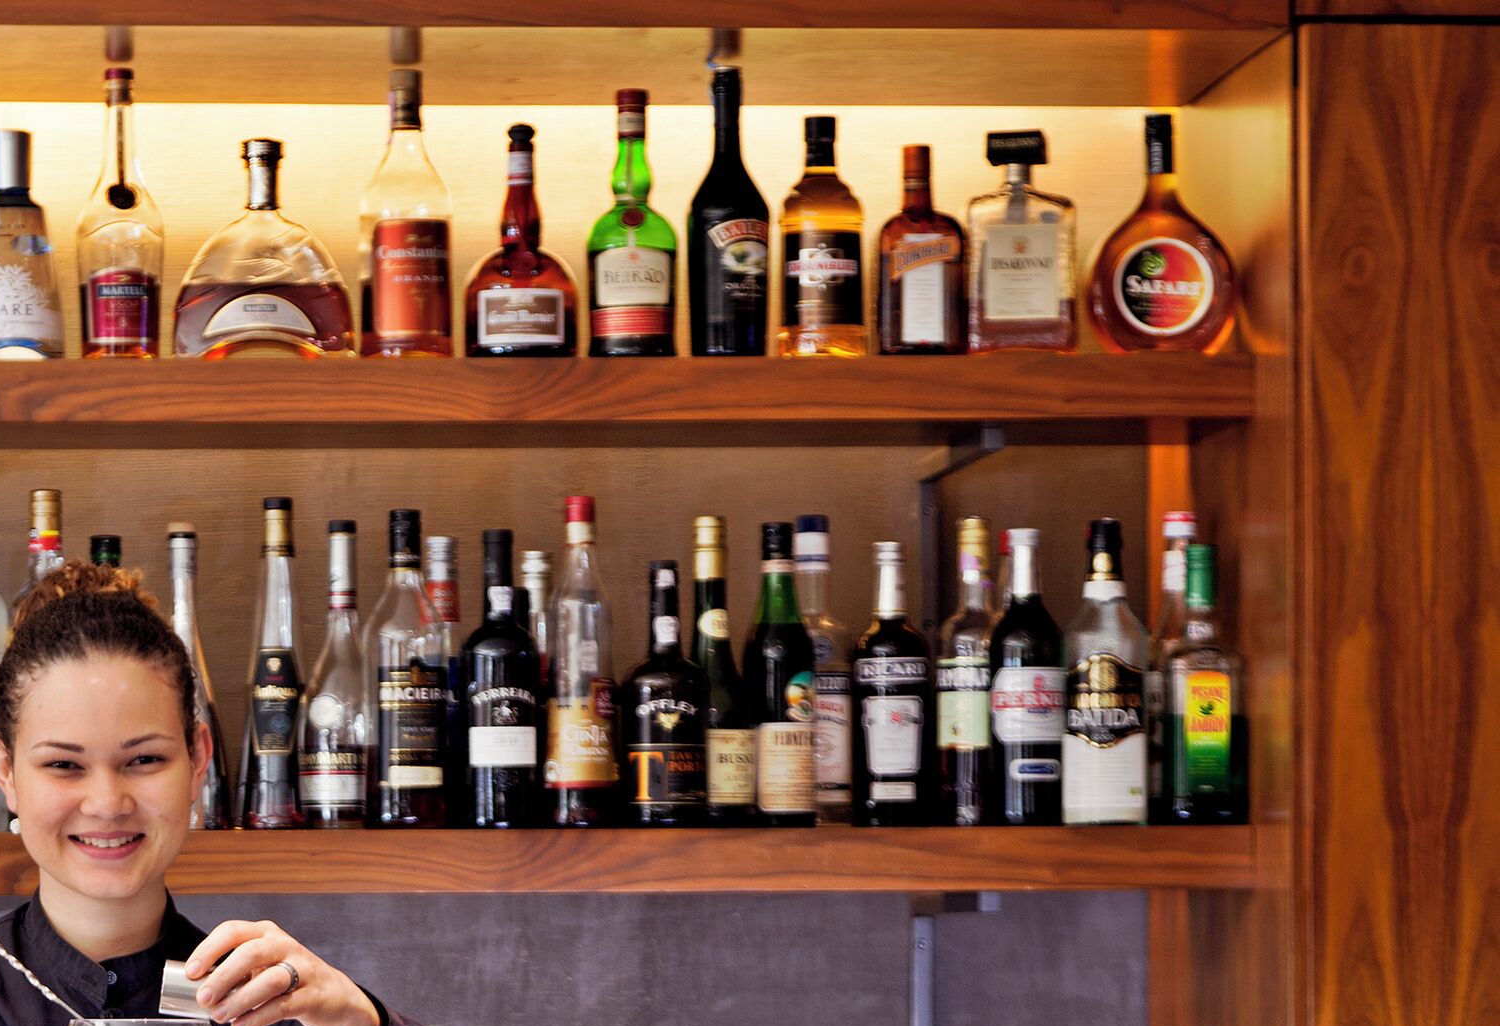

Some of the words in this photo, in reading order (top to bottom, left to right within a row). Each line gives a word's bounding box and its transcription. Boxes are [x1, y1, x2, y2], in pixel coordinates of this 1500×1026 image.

[862, 662, 926, 677] RICARD
[1068, 707, 1141, 728] BATIDA
[628, 751, 664, 800] T
